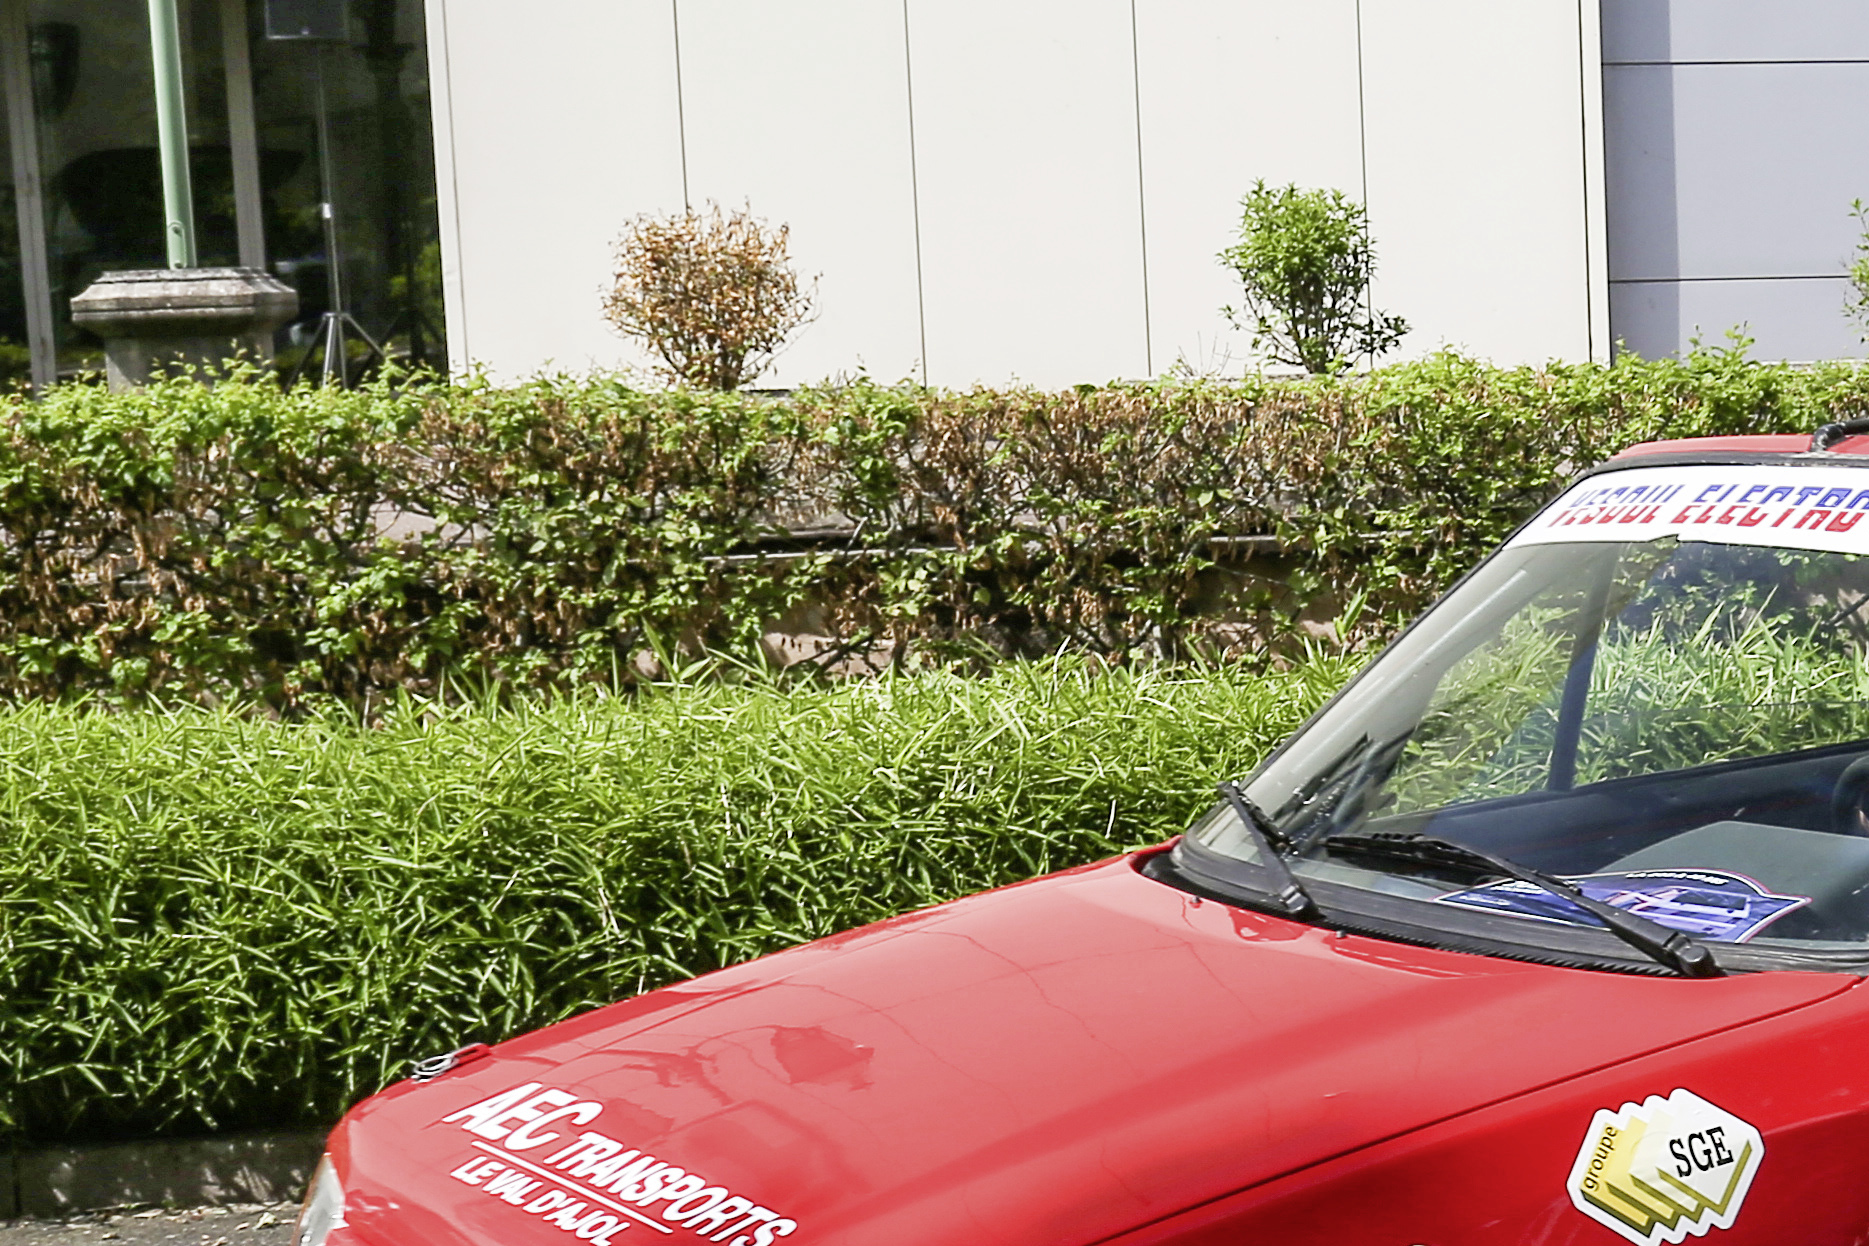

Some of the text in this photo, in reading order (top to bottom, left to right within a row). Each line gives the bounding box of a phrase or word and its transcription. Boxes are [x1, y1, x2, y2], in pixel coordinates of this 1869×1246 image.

[442, 1081, 603, 1151] AEC
[450, 1155, 499, 1186] LE
[482, 1168, 543, 1206] VAL
[1583, 1125, 1619, 1191] groupe
[1669, 1126, 1734, 1178] SGE
